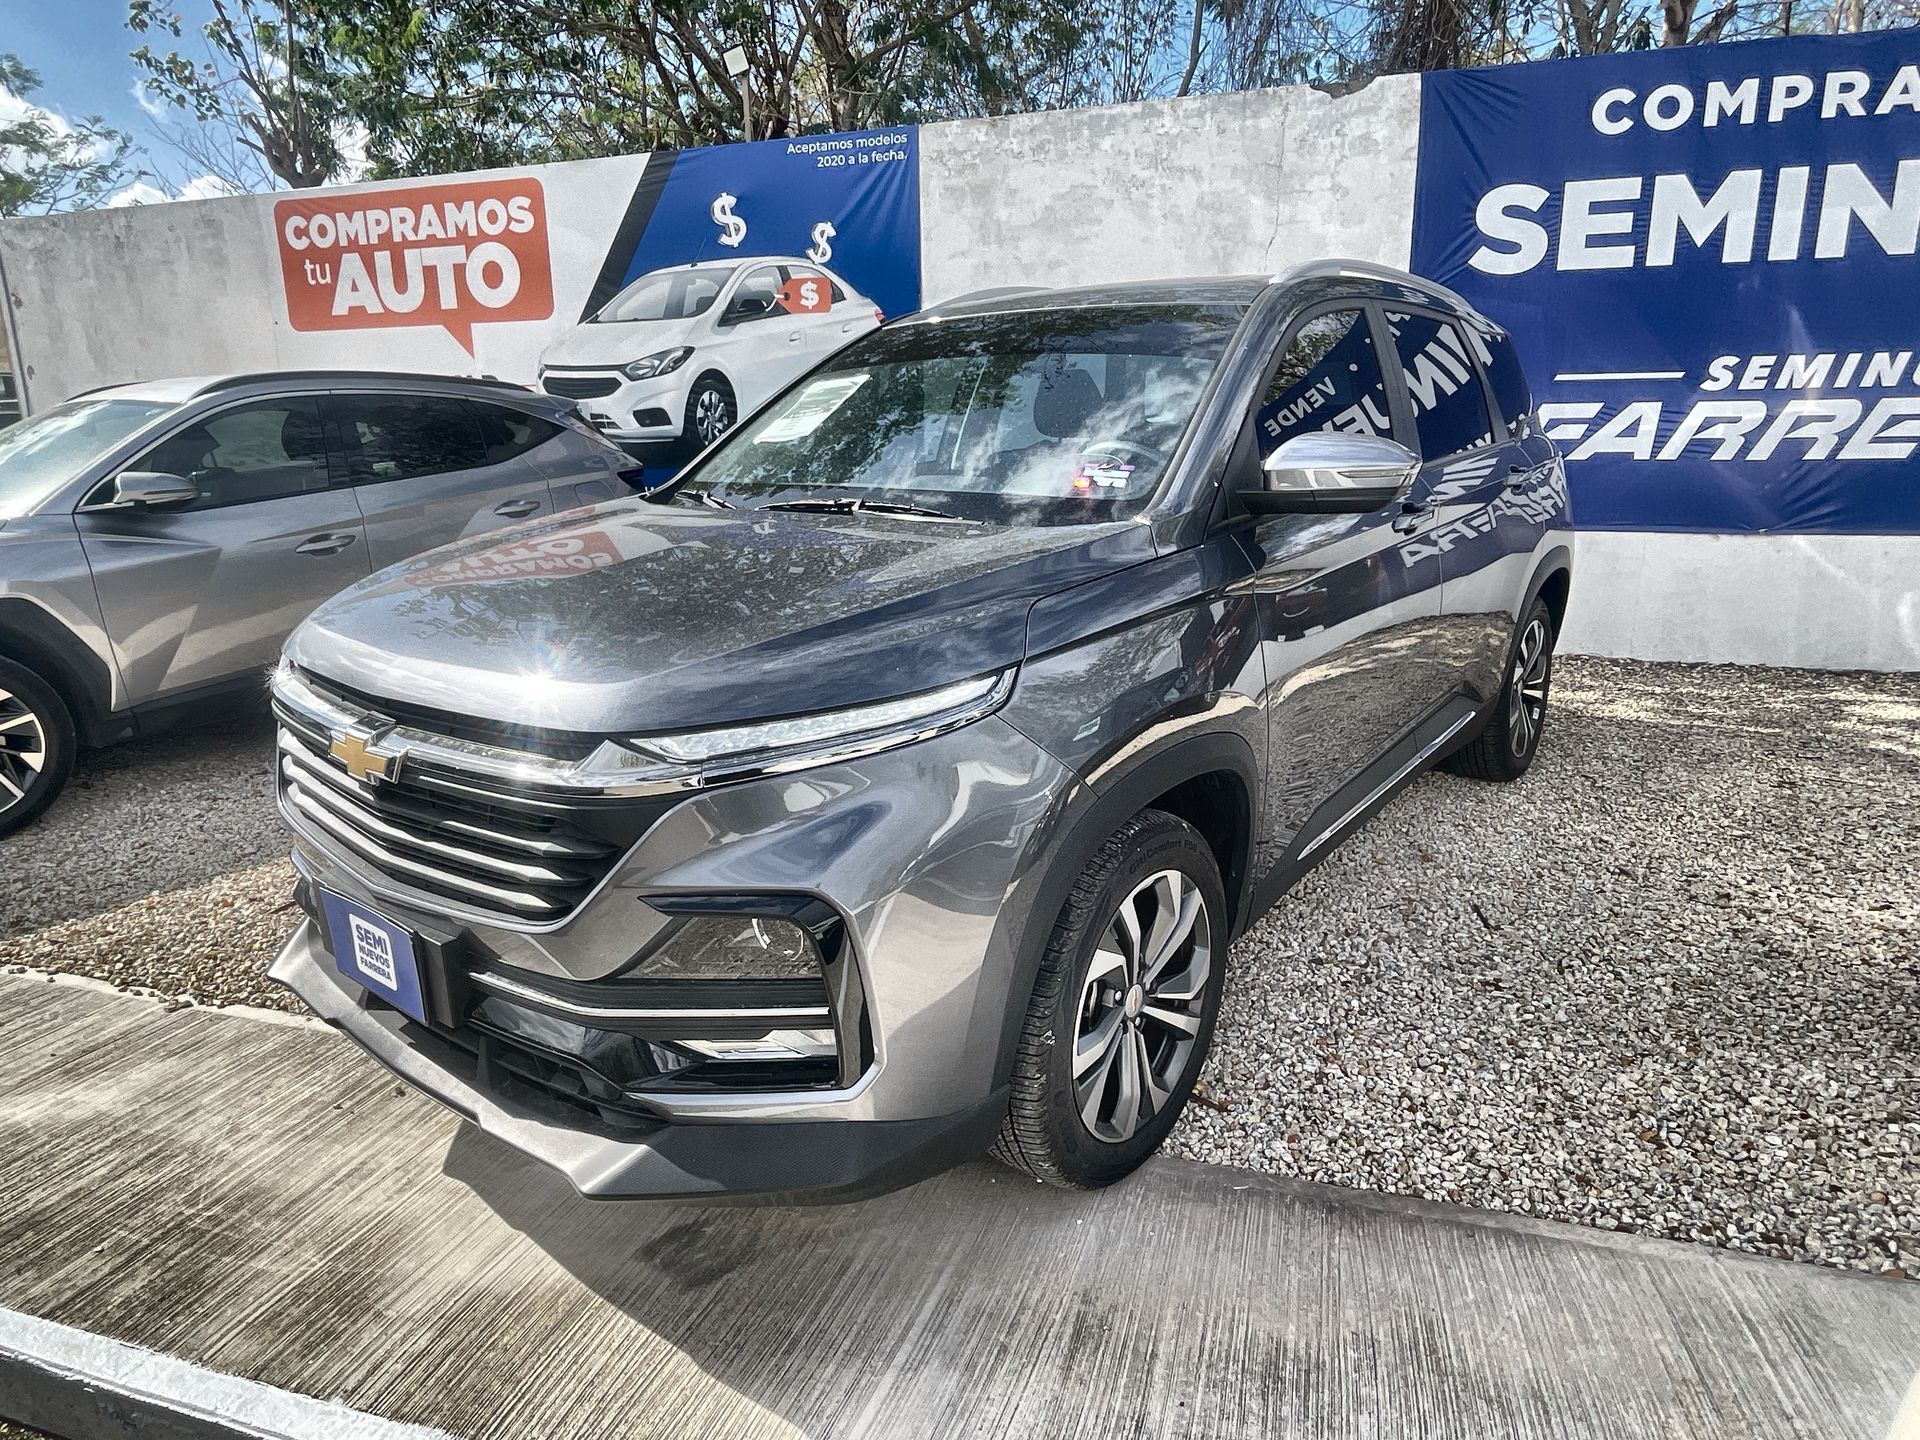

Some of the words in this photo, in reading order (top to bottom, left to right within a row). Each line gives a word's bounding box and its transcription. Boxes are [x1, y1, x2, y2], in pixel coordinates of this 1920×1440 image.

[1591, 64, 1920, 136] COMPRA
[786, 139, 854, 155] Aceptamos
[856, 133, 908, 149] modelos
[817, 154, 846, 168] 2020
[848, 155, 856, 165] a
[858, 153, 869, 164] la
[871, 149, 908, 163] fecha.
[284, 196, 535, 251] COMPRAMOS
[1467, 158, 1920, 276] SEMIN
[304, 258, 332, 285] tu
[331, 241, 521, 316] AUTO
[1699, 350, 1920, 392] SEMIN
[355, 923, 389, 957] SEMI
[358, 944, 391, 969] NUEVOS
[360, 956, 393, 982] FARRERA
